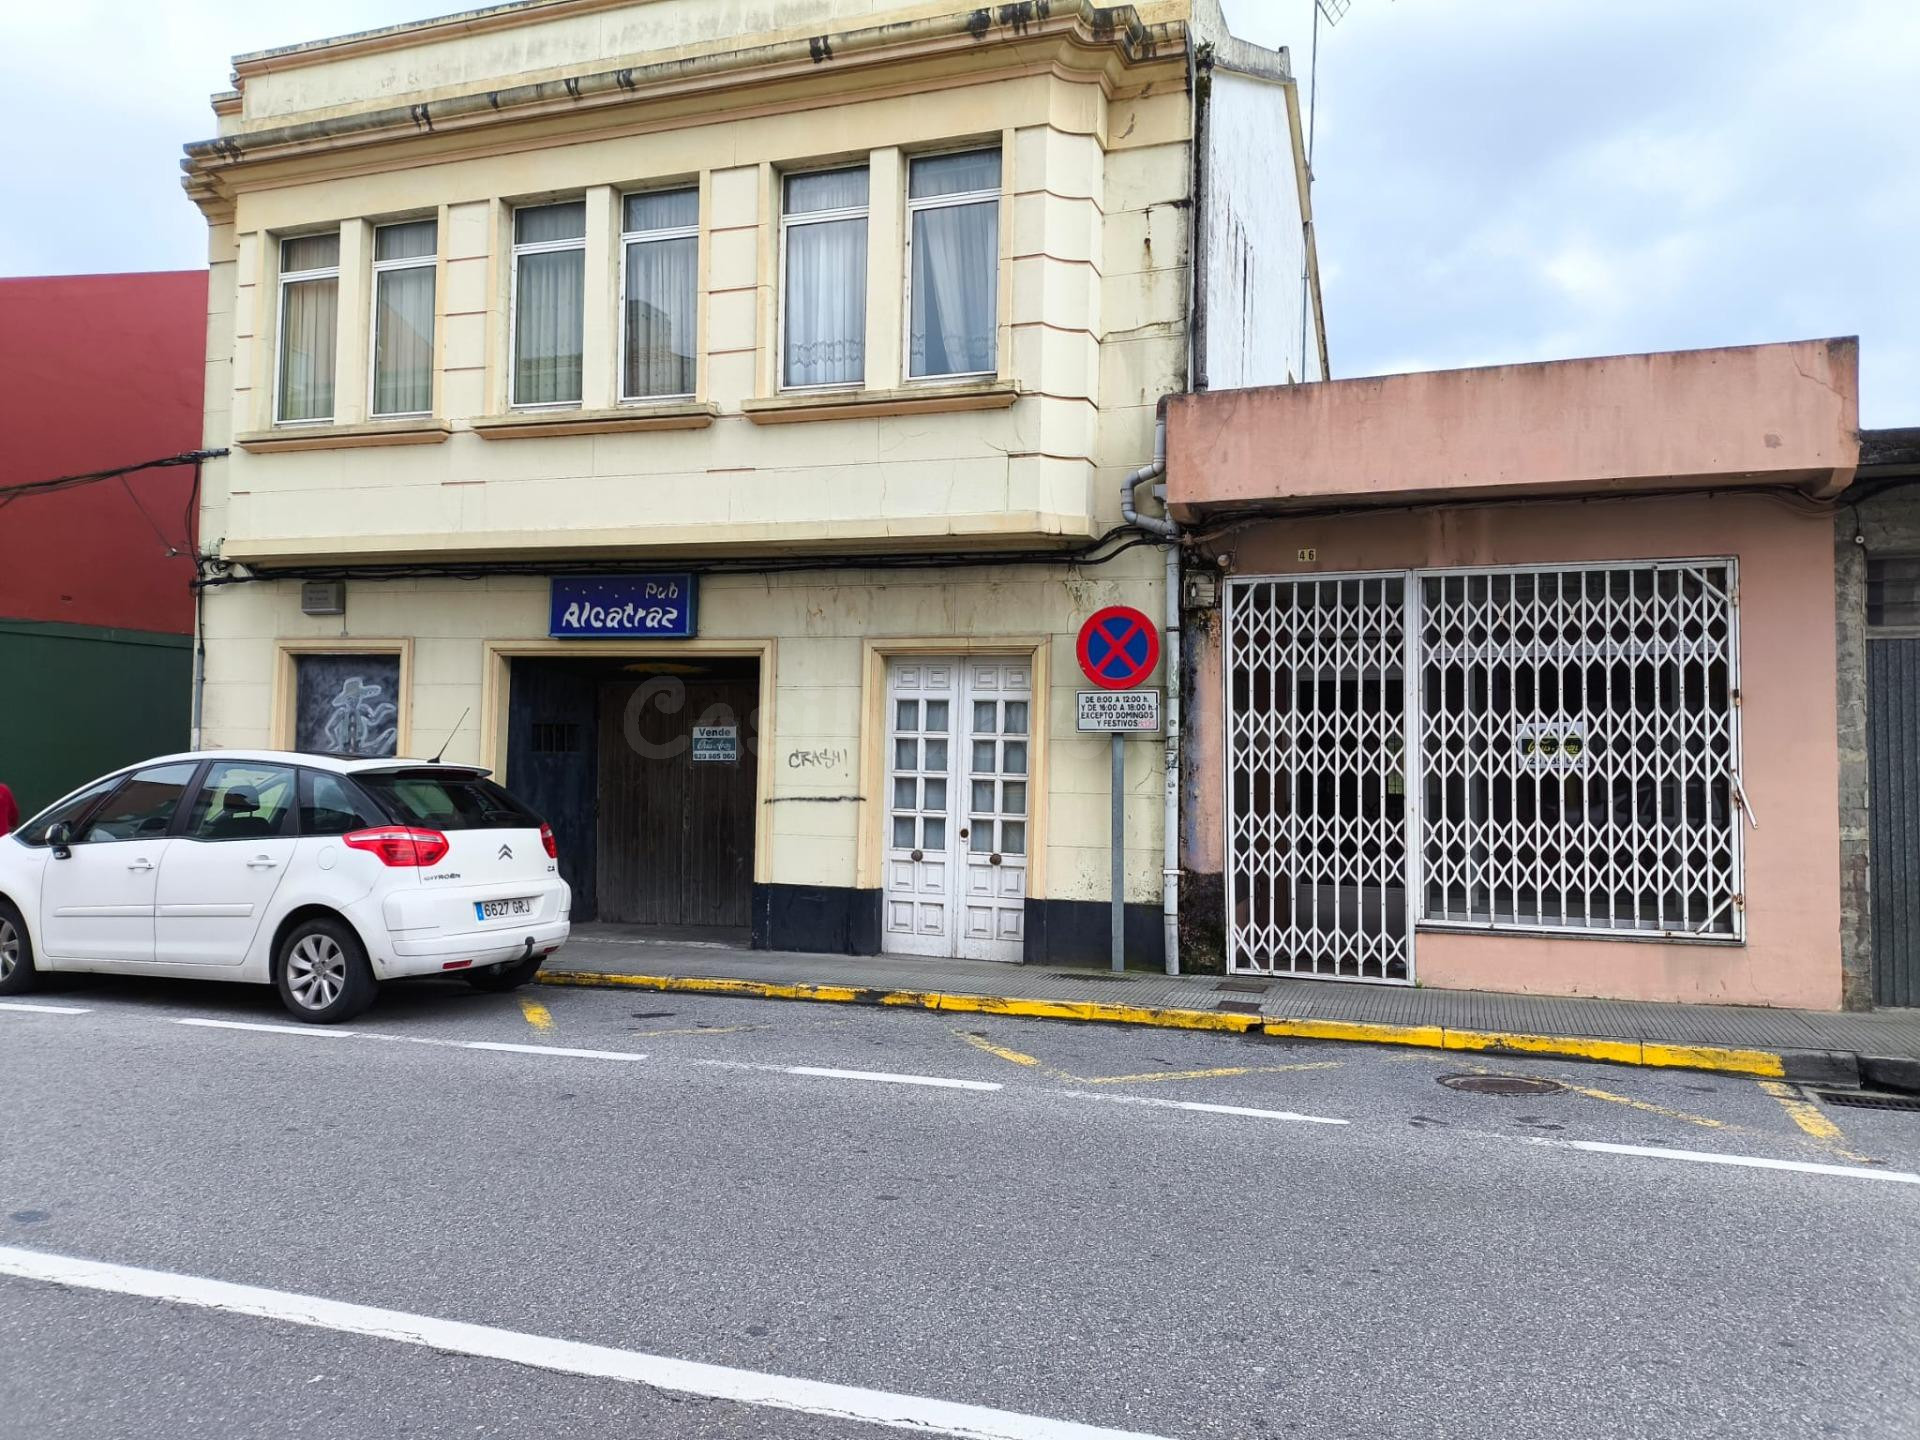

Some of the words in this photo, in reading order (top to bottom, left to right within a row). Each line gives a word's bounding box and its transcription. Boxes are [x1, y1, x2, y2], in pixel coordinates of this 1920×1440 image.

[1299, 549, 1315, 561] 46
[645, 582, 679, 599] Pub
[562, 602, 678, 628] Alcatraz
[1115, 711, 1154, 719] DOMINGOS
[698, 728, 731, 737] Vende
[484, 901, 509, 917] 6627
[512, 899, 530, 914] GRJ
